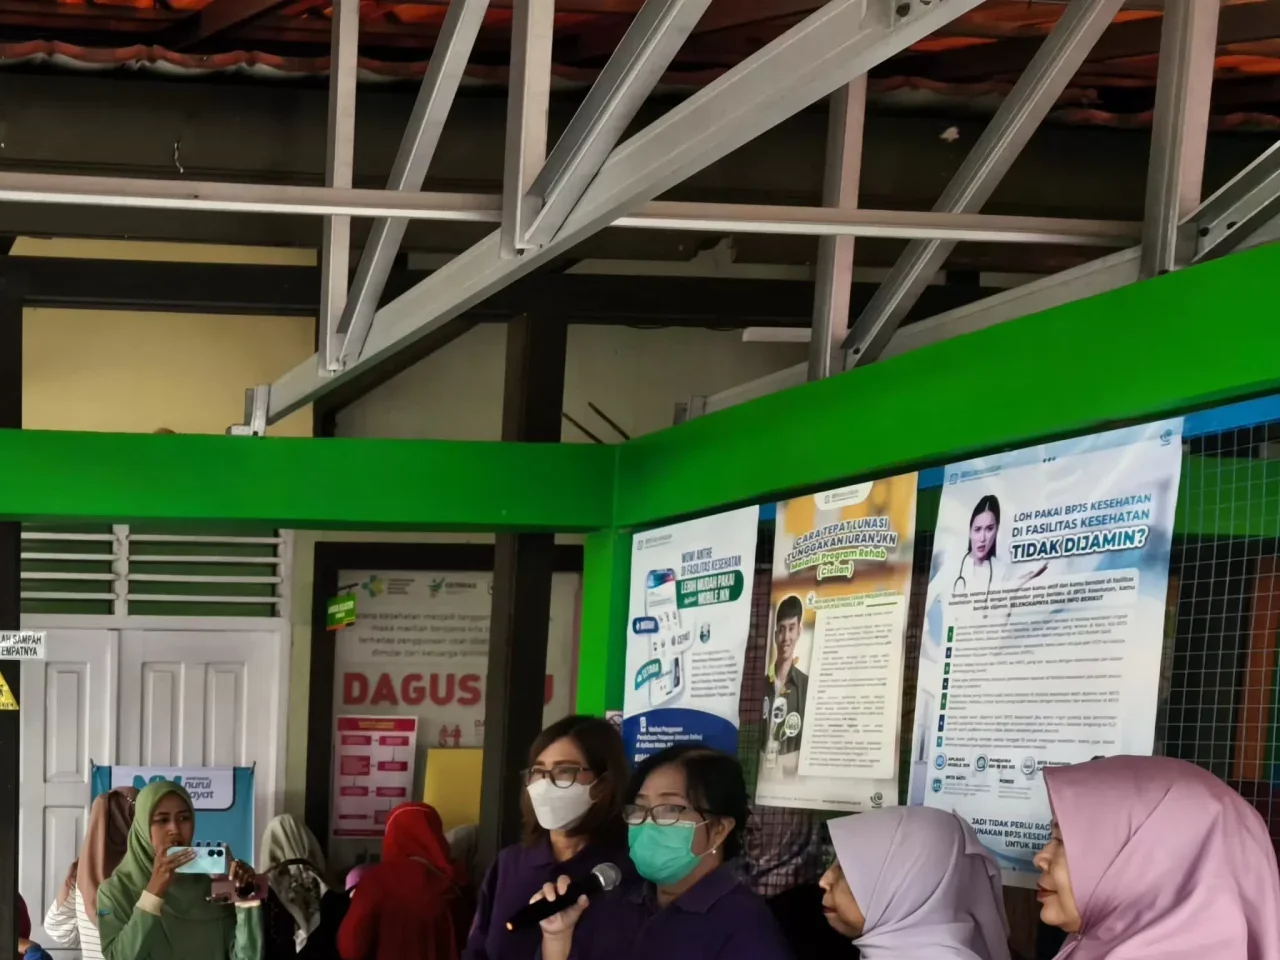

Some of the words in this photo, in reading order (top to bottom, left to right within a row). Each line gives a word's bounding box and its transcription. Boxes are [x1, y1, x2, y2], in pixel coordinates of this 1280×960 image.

[1013, 511, 1032, 523] LOH
[1035, 507, 1063, 520] PAKAI
[1065, 503, 1088, 516] BPJS
[1090, 493, 1152, 511] KESEHATAN
[1012, 526, 1023, 537] DI
[1025, 518, 1077, 536] FASILITAS
[1080, 509, 1150, 528] KESEHATAN
[795, 530, 821, 546] CARA
[823, 521, 851, 536] TEPAT
[852, 518, 888, 530] LUNASI
[786, 537, 844, 560] TUNGGAKAN
[845, 533, 875, 546] IURAN
[877, 533, 897, 546] JKN
[1012, 538, 1060, 560] TIDAK
[1065, 529, 1148, 553] DIJAMIN?
[711, 555, 742, 571] KESEHATAN
[791, 554, 821, 570] Melalui
[821, 549, 857, 563] Program
[859, 547, 886, 559] Rehab
[817, 562, 853, 579] (Cicilan)
[13, 634, 41, 645] SAMPAH
[184, 780, 211, 790] nurul
[190, 791, 214, 800] ayat
[972, 817, 987, 826] JADI
[988, 818, 1009, 828] TIDAK
[1010, 820, 1033, 830] PERLU
[975, 827, 1003, 837] UNAKAN
[1005, 829, 1021, 839] BPJS
[1005, 840, 1030, 850] UNTUK
